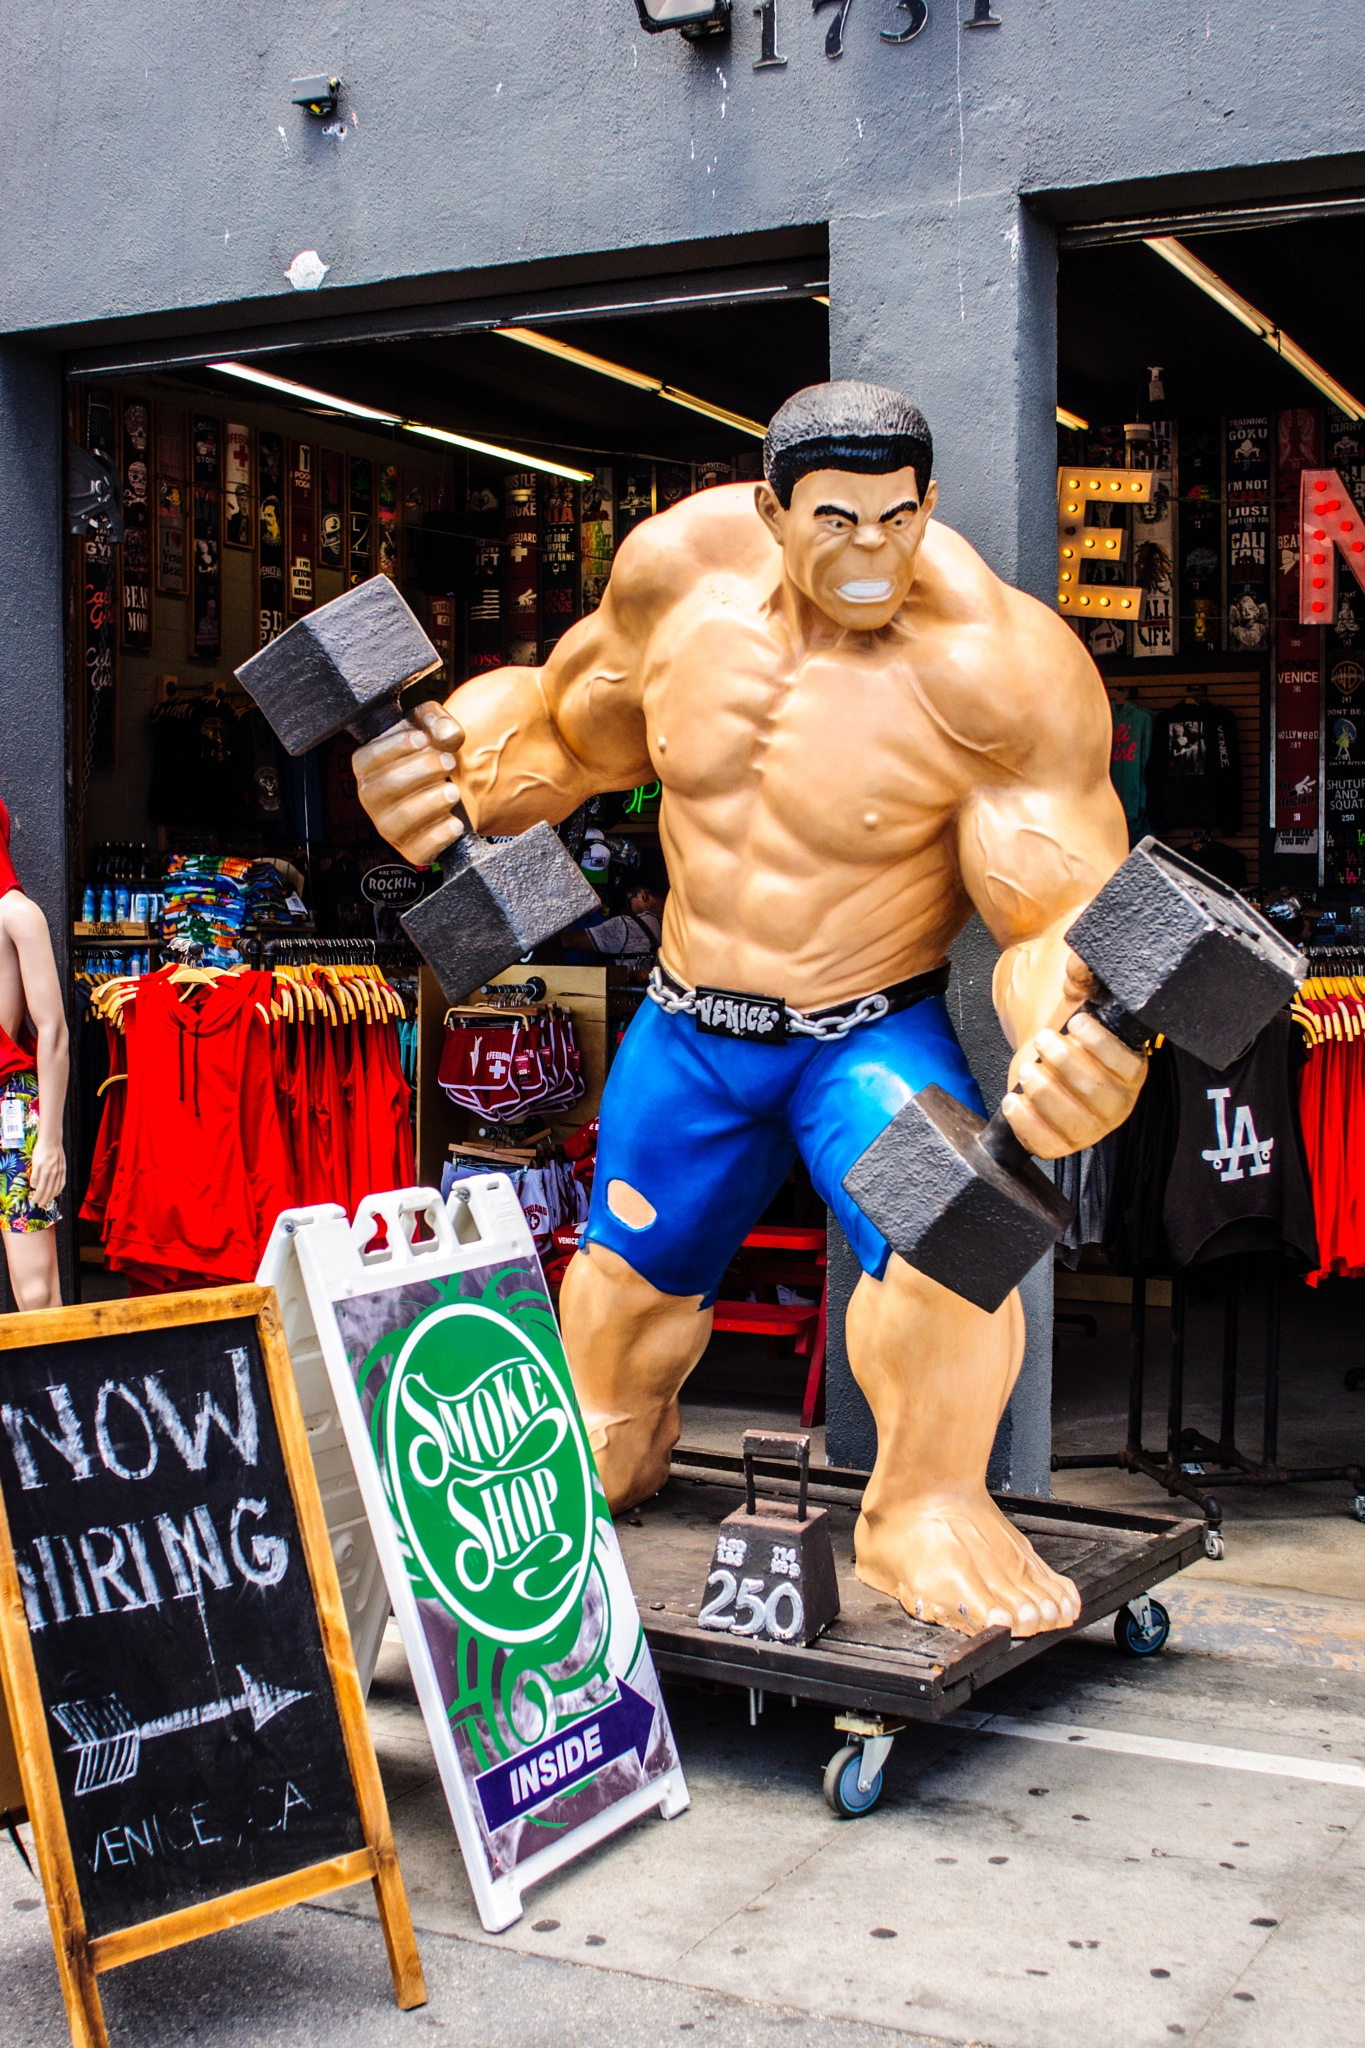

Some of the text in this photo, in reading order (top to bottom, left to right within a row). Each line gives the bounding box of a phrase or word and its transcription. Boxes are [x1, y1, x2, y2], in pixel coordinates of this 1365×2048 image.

[1229, 418, 1268, 427] TRAINING
[1331, 422, 1364, 433] CURRY
[1228, 428, 1268, 441] GOKU
[505, 473, 537, 489] HUSTLE
[1228, 480, 1268, 492] I'M NOT
[505, 502, 537, 519] BROKE
[1228, 506, 1268, 518] I JUST
[165, 531, 170, 546] I
[553, 533, 571, 543] SOME
[1055, 466, 1152, 620] E
[1231, 532, 1265, 550] CALI
[557, 552, 576, 561] NAME
[1277, 671, 1319, 684] VENICE
[1326, 708, 1362, 717] DONT BE
[1216, 724, 1230, 769] VENICE
[1334, 789, 1359, 801] AND
[1340, 814, 1355, 822] 250
[1291, 828, 1314, 837] BREAK
[1280, 837, 1310, 846] YOU BUY
[699, 994, 773, 1034] VENICE
[1201, 1087, 1274, 1183] LA
[1, 1346, 259, 1490] NOW
[400, 1356, 569, 1488] SMOKE
[446, 1467, 573, 1593] SHOP
[14, 1497, 289, 1632] HIRING
[698, 1568, 804, 1640] 250
[509, 1722, 603, 1806] INSIDE
